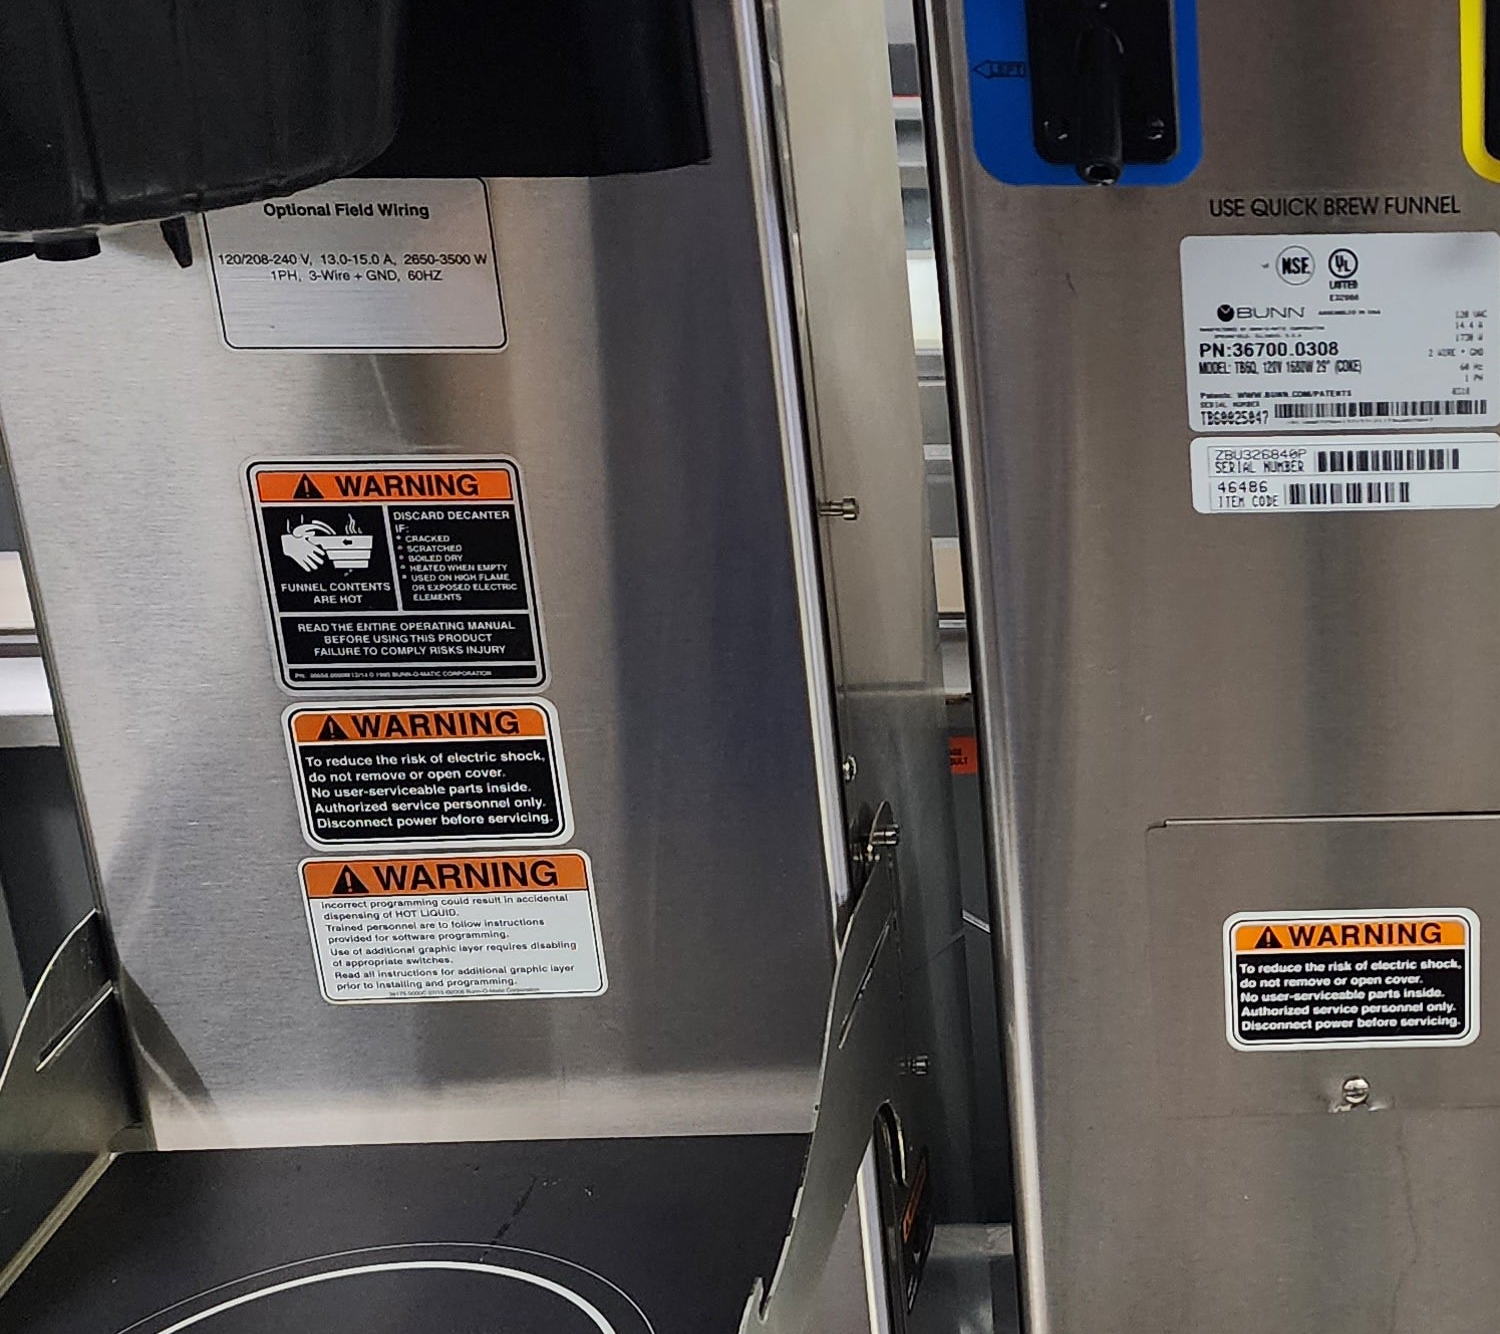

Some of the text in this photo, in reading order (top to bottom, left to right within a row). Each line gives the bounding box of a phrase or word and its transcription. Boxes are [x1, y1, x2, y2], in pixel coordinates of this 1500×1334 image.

[264, 203, 429, 219] Optional Field Wiring
[1210, 195, 1461, 217] USE QUICK BREW FUNNEL
[219, 254, 487, 267] 120/208-240 V, 13.0-15.0 A, 2650-3500 W
[271, 271, 301, 282] 1PH,
[309, 270, 350, 281] 3-Wire
[366, 270, 400, 282] GND,
[408, 270, 443, 280] 60HZ
[1237, 307, 1305, 318] BUNN
[1200, 342, 1339, 358] PN:36700.0308
[1215, 461, 1304, 474] SERIAL NUMBER
[335, 473, 479, 496] WARNING
[1218, 481, 1268, 493] 46486
[1218, 495, 1279, 508] ITEM CODE
[393, 511, 510, 520] DISCARD DECANTER
[444, 554, 463, 562] DRY
[410, 564, 446, 572] HEATED
[281, 582, 391, 592] FUNNEL CONTENTS
[314, 594, 362, 604] ARE HOT
[298, 621, 515, 632] READ THE ENTIRE OPERATING MANUAL
[324, 633, 492, 643] BEFORE USING THIS PRODUCT
[314, 645, 505, 656] FAILURE TO COMPLY RISKS INJURY
[351, 711, 520, 738] WARNING
[305, 751, 545, 767] To reduce the risk of electric shock,
[309, 769, 505, 782] do not remove or open cover.
[312, 782, 531, 798] No user-serviceable parts inside.
[315, 797, 546, 813] Authorized service personnel only.
[317, 812, 553, 828] Disconnect power before servicing.
[373, 860, 559, 891] WARNING
[321, 900, 367, 909] Incorrect
[370, 898, 438, 908] programming
[441, 897, 469, 905] could
[472, 896, 501, 904] result
[516, 894, 568, 903] accidental
[324, 909, 459, 921] dispensing of HOT LIQUID.
[1288, 923, 1442, 946] WARNING
[1240, 963, 1255, 974] To
[1258, 962, 1302, 973] reduce
[1305, 962, 1325, 972] the
[1328, 961, 1351, 972] risk
[1355, 961, 1367, 971] of
[1370, 960, 1417, 971] electric
[1240, 975, 1423, 988] do not remove or open cover.
[1241, 987, 1444, 1002] No user-serviceable parts inside.
